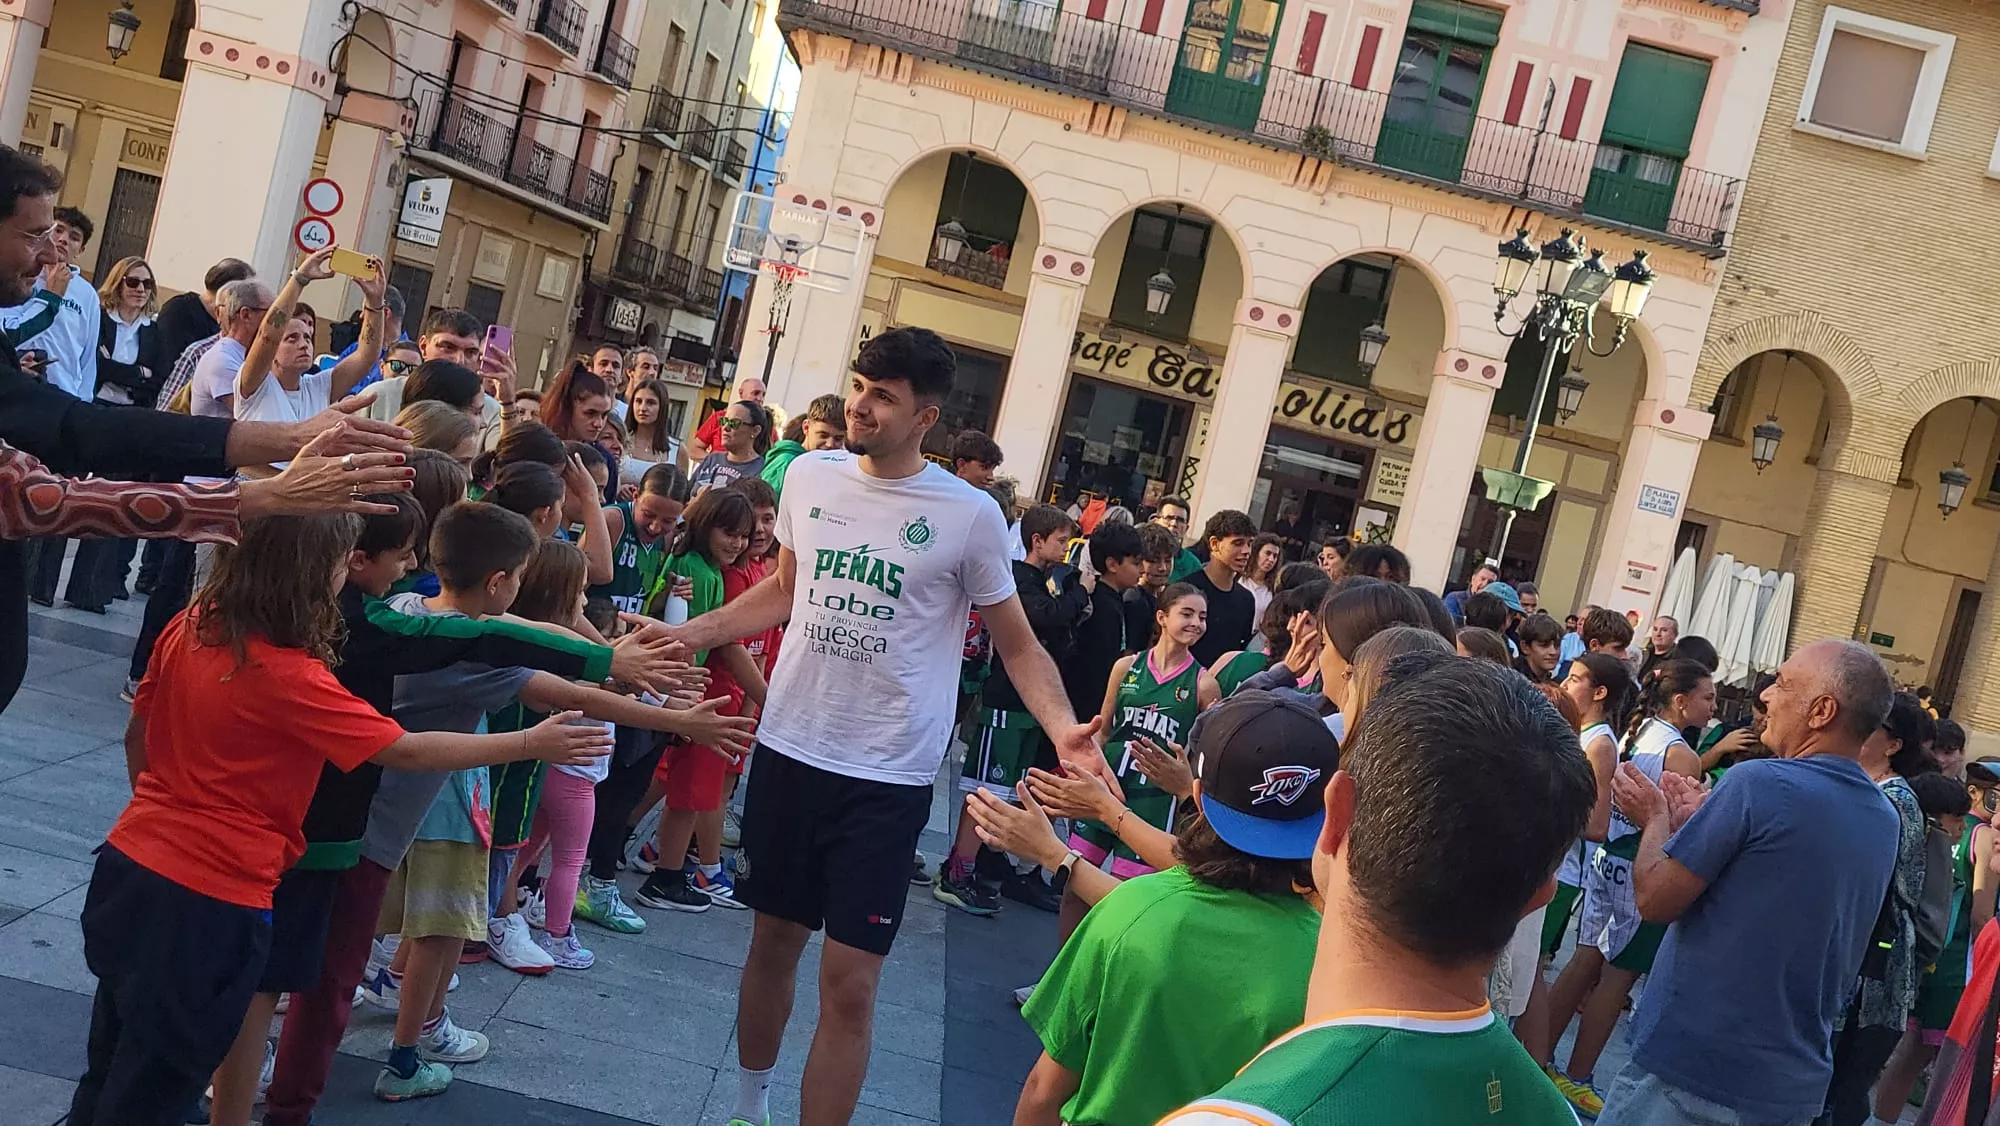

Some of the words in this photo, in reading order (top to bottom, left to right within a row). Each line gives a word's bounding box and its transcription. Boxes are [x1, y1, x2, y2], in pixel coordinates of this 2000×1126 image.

[408, 200, 440, 216] VELTINS
[778, 209, 819, 227] TARMAK
[619, 541, 638, 568] 88
[808, 588, 895, 621] Lobe
[815, 611, 826, 621] TU
[1265, 774, 1302, 796] OKC
